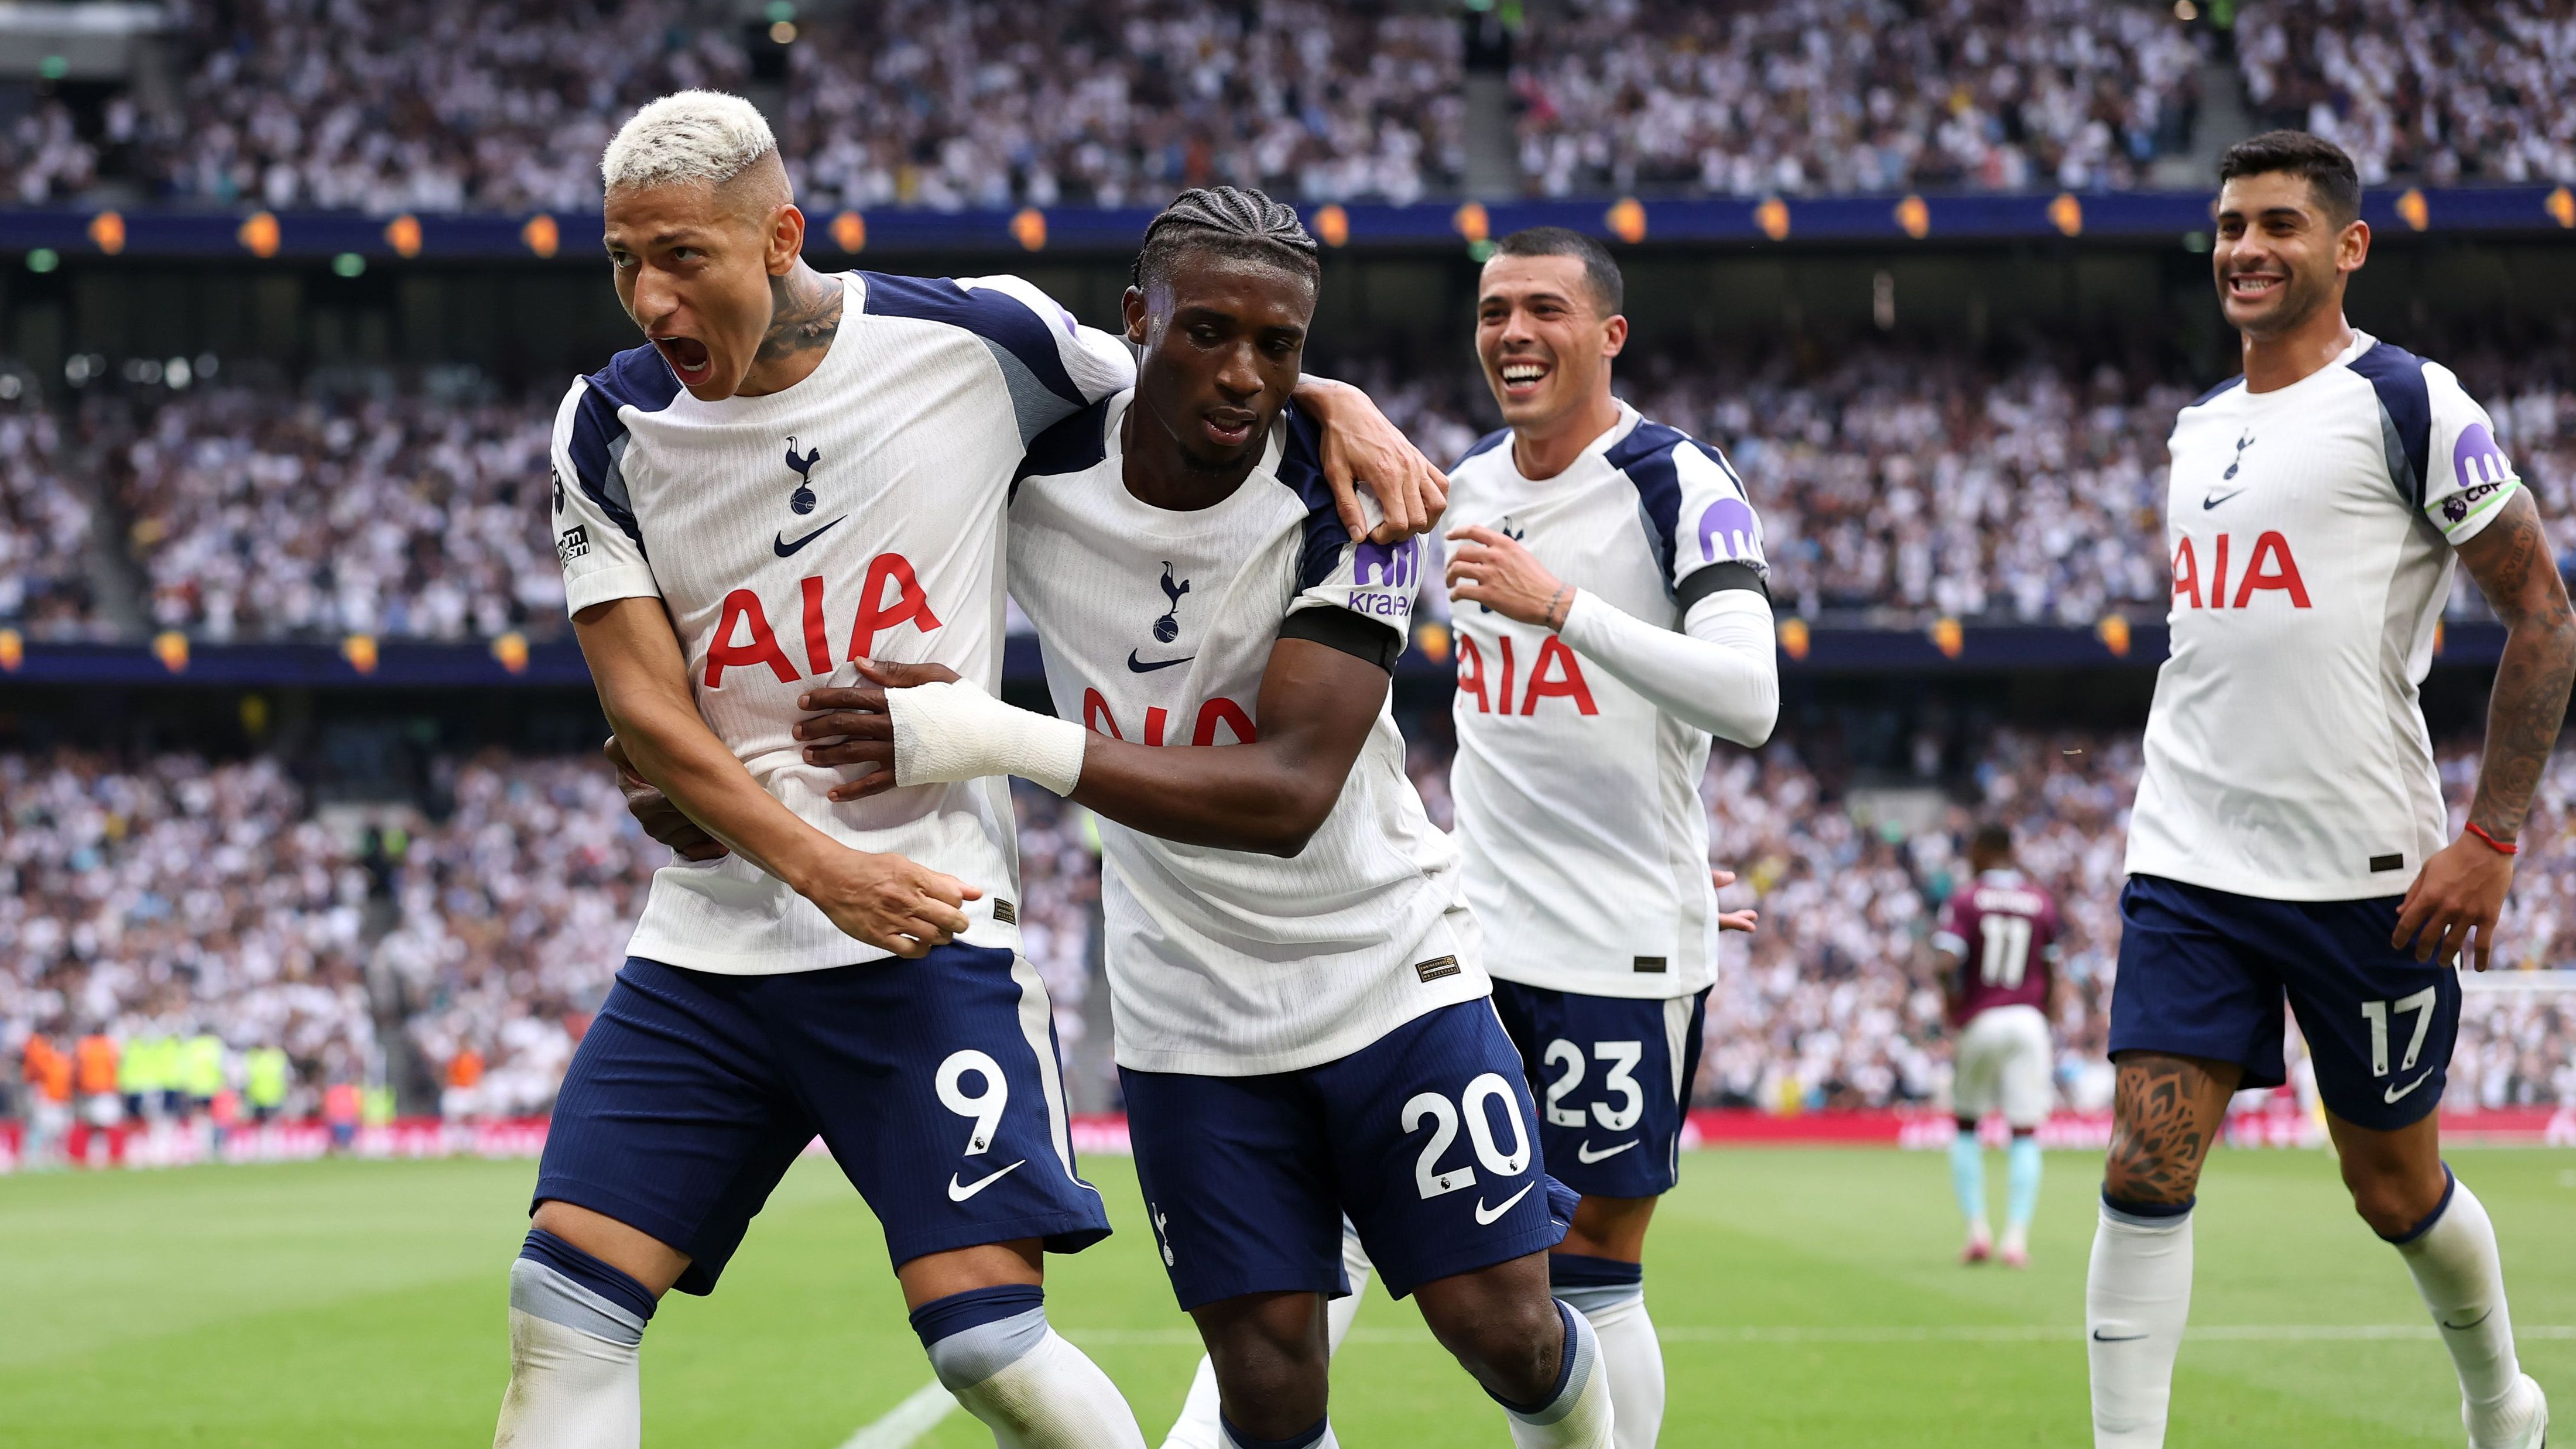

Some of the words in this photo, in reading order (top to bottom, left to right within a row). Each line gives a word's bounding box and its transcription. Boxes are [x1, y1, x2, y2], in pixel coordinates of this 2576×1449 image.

[2171, 530, 2312, 609] AIA
[704, 552, 942, 688] AIA
[1458, 633, 1599, 716] AIA
[1979, 913, 2032, 991] 11
[2362, 985, 2436, 1077] 17
[936, 1049, 1008, 1156] 9
[1544, 1038, 1643, 1131] 23
[1401, 1073, 1531, 1200] 20
